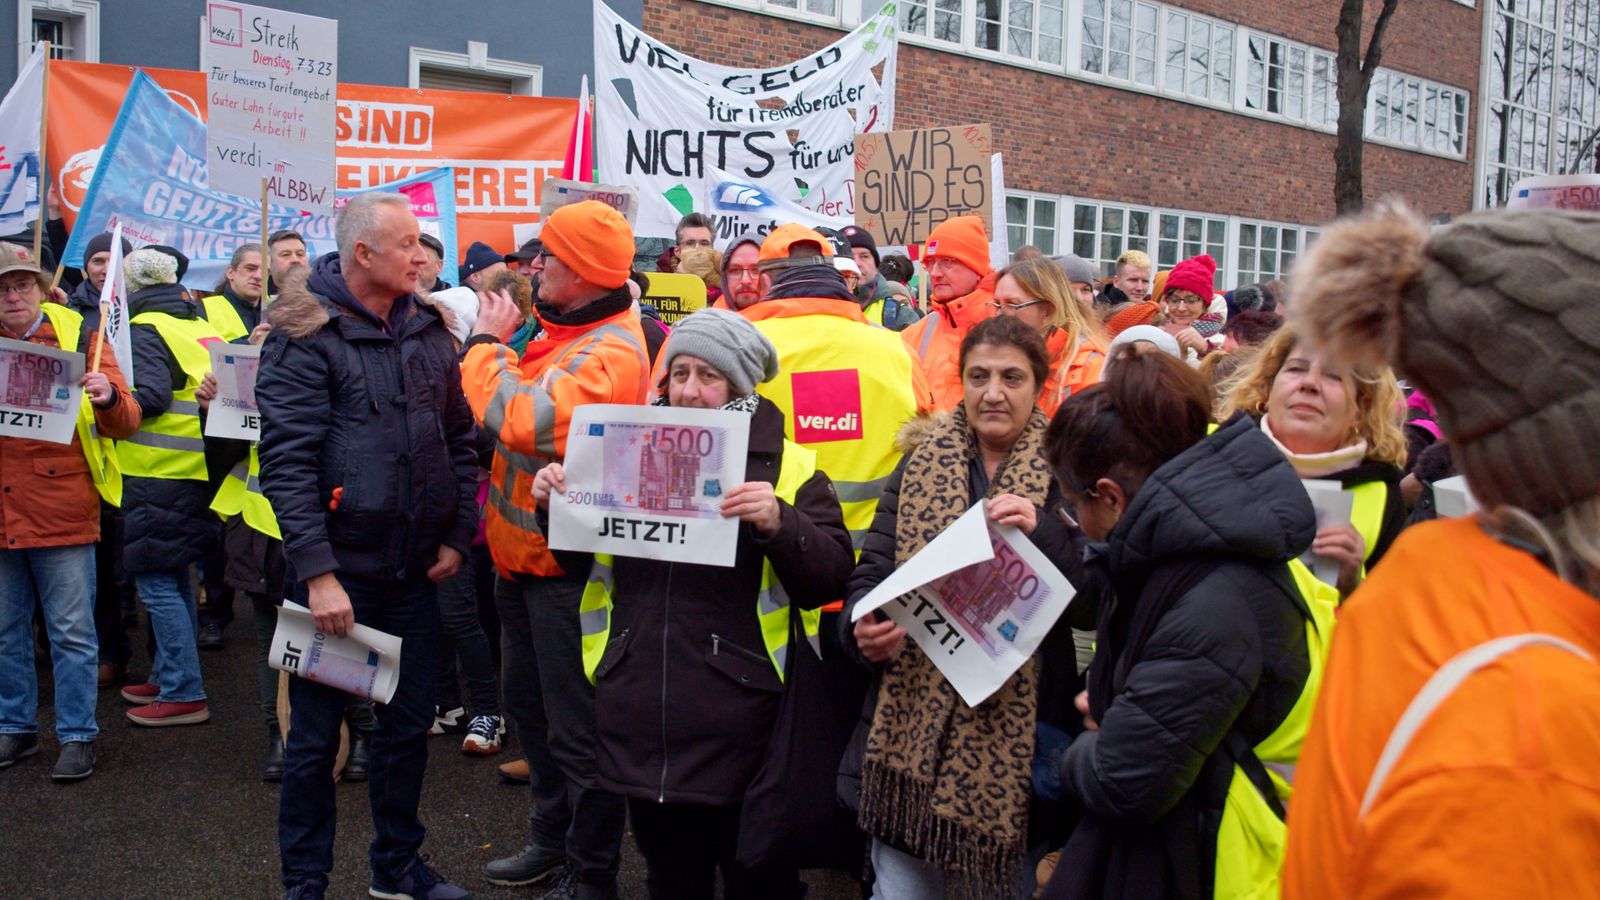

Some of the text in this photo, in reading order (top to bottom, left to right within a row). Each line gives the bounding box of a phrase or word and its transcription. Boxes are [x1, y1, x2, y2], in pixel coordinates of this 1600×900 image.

[251, 17, 299, 51] Streik
[615, 24, 841, 95] VIEL GELD
[233, 70, 266, 88] besseres
[269, 77, 331, 104] Tarifangebot
[212, 91, 238, 110] Guter
[243, 97, 264, 114] Lohn
[706, 97, 743, 122] für
[252, 118, 292, 139] Arbeit
[336, 104, 431, 146] SIND
[217, 142, 262, 168] ver.di
[626, 129, 855, 179] NICHTS für un
[884, 129, 955, 172] WIR
[266, 176, 327, 205] ALBBW
[863, 169, 935, 214] SIND
[944, 164, 985, 209] ES
[711, 214, 750, 240] Wir
[661, 298, 678, 311] FÜR
[25, 353, 63, 376] 500
[0, 411, 43, 429] TZT!
[241, 415, 261, 430] JE
[798, 412, 858, 431] ver.di
[663, 427, 714, 458] 500
[567, 491, 592, 505] 500
[598, 516, 687, 545] JETZT!
[989, 544, 1039, 601] 500
